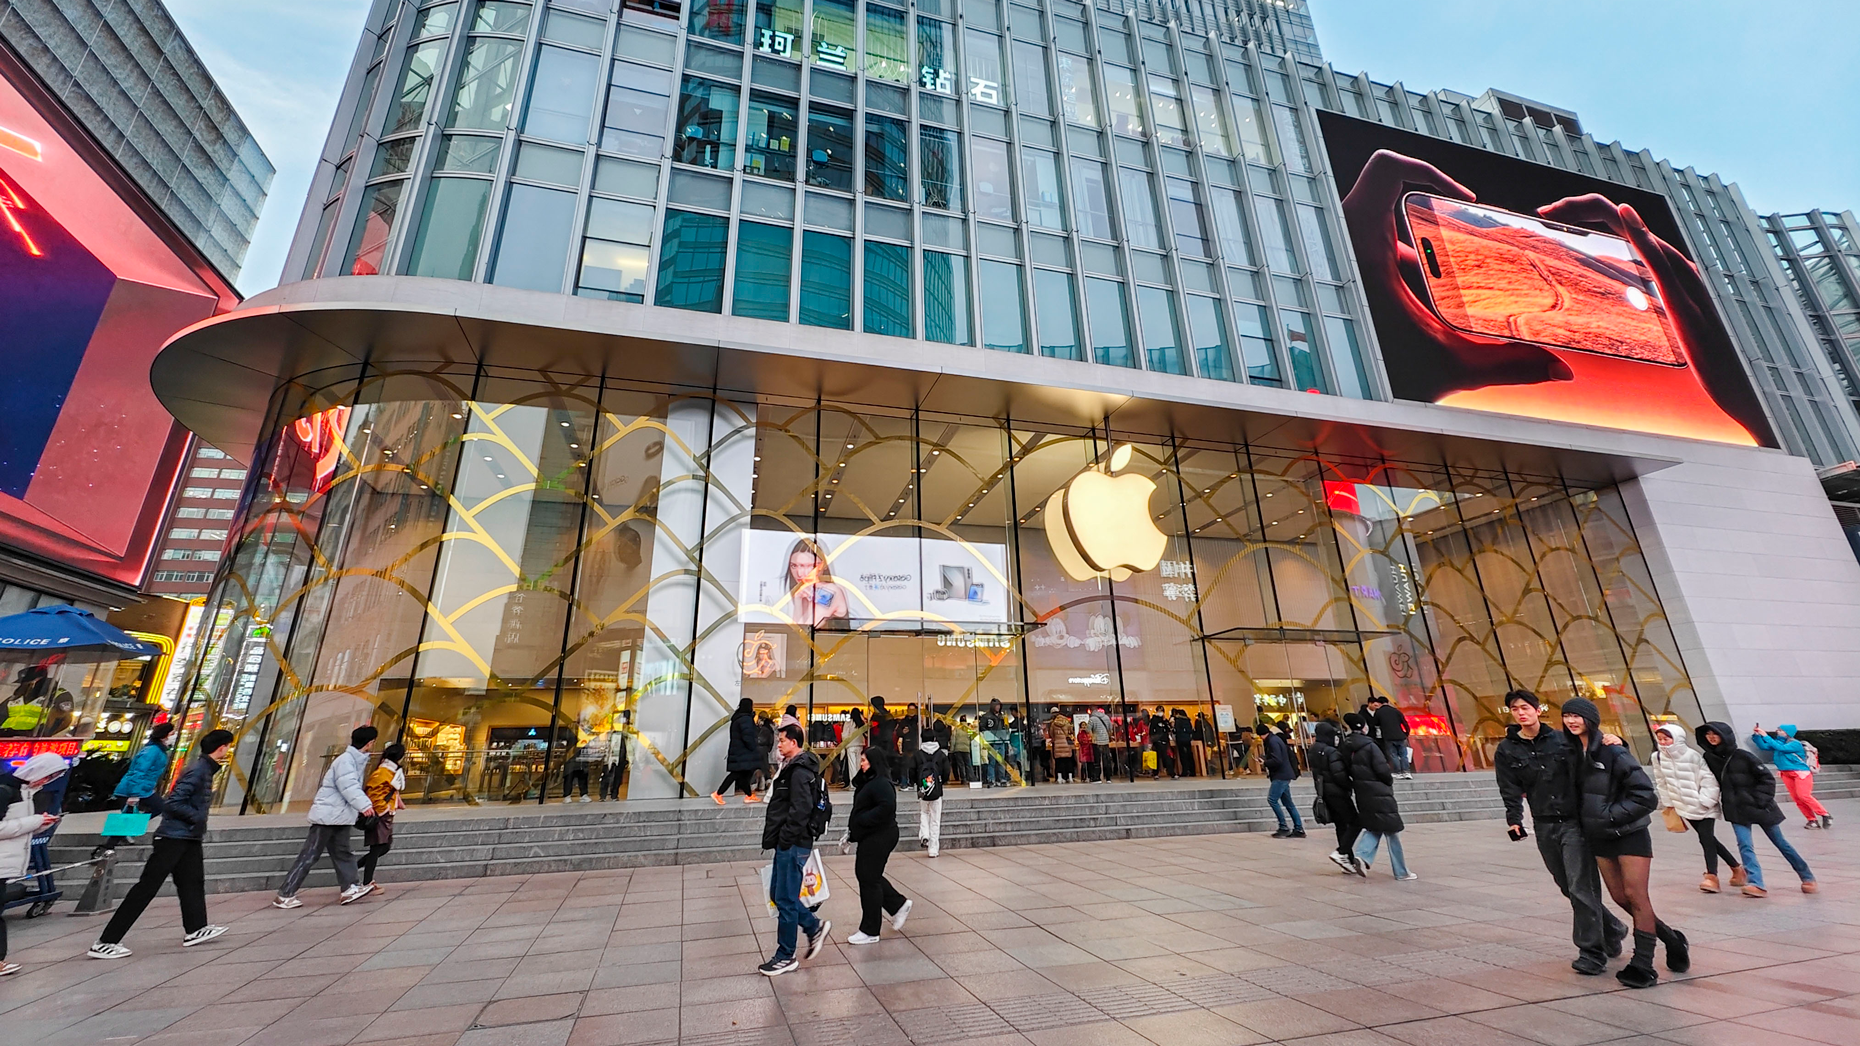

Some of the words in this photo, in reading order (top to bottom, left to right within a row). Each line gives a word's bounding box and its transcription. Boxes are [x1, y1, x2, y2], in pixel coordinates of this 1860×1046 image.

[759, 28, 999, 105] 珂兰钻石
[0, 637, 52, 645] OLICE
